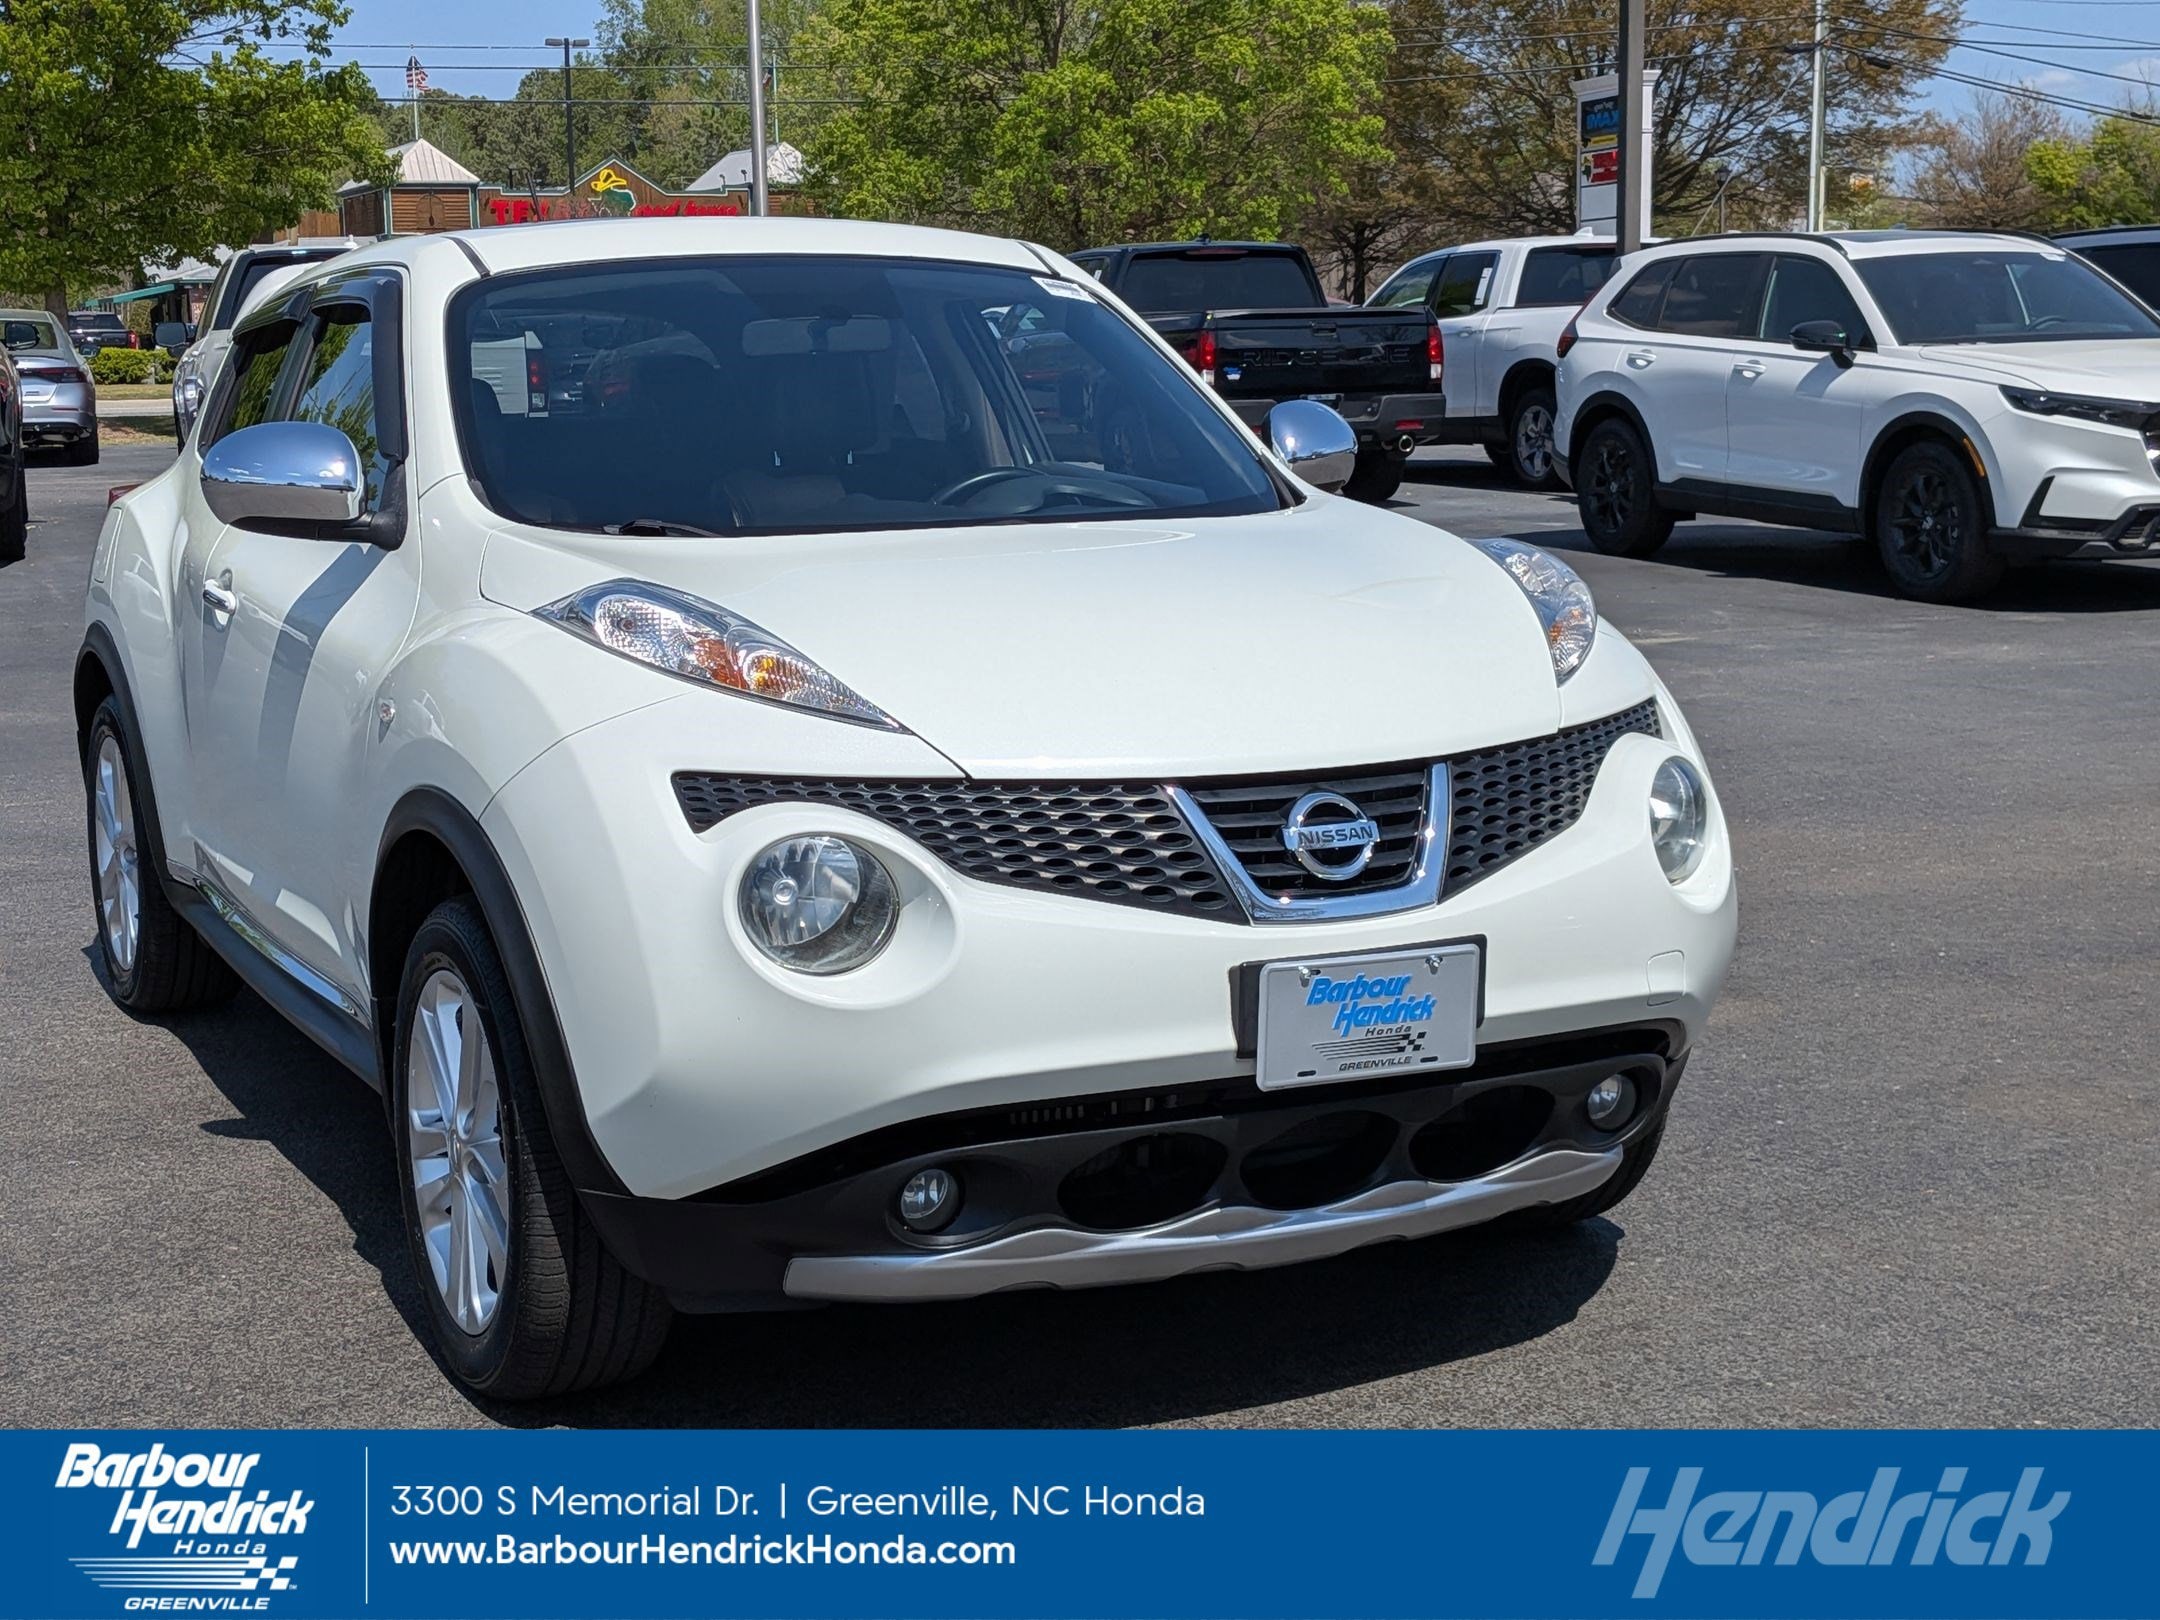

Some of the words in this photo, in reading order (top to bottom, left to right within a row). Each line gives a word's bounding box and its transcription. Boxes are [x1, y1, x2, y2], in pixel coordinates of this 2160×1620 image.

[1298, 825, 1374, 845] NISSAN
[1306, 972, 1413, 1006] Barbour
[1332, 992, 1438, 1038] Hendrick
[1365, 1025, 1413, 1037] Honda
[1338, 1056, 1413, 1072] GREENVILLE
